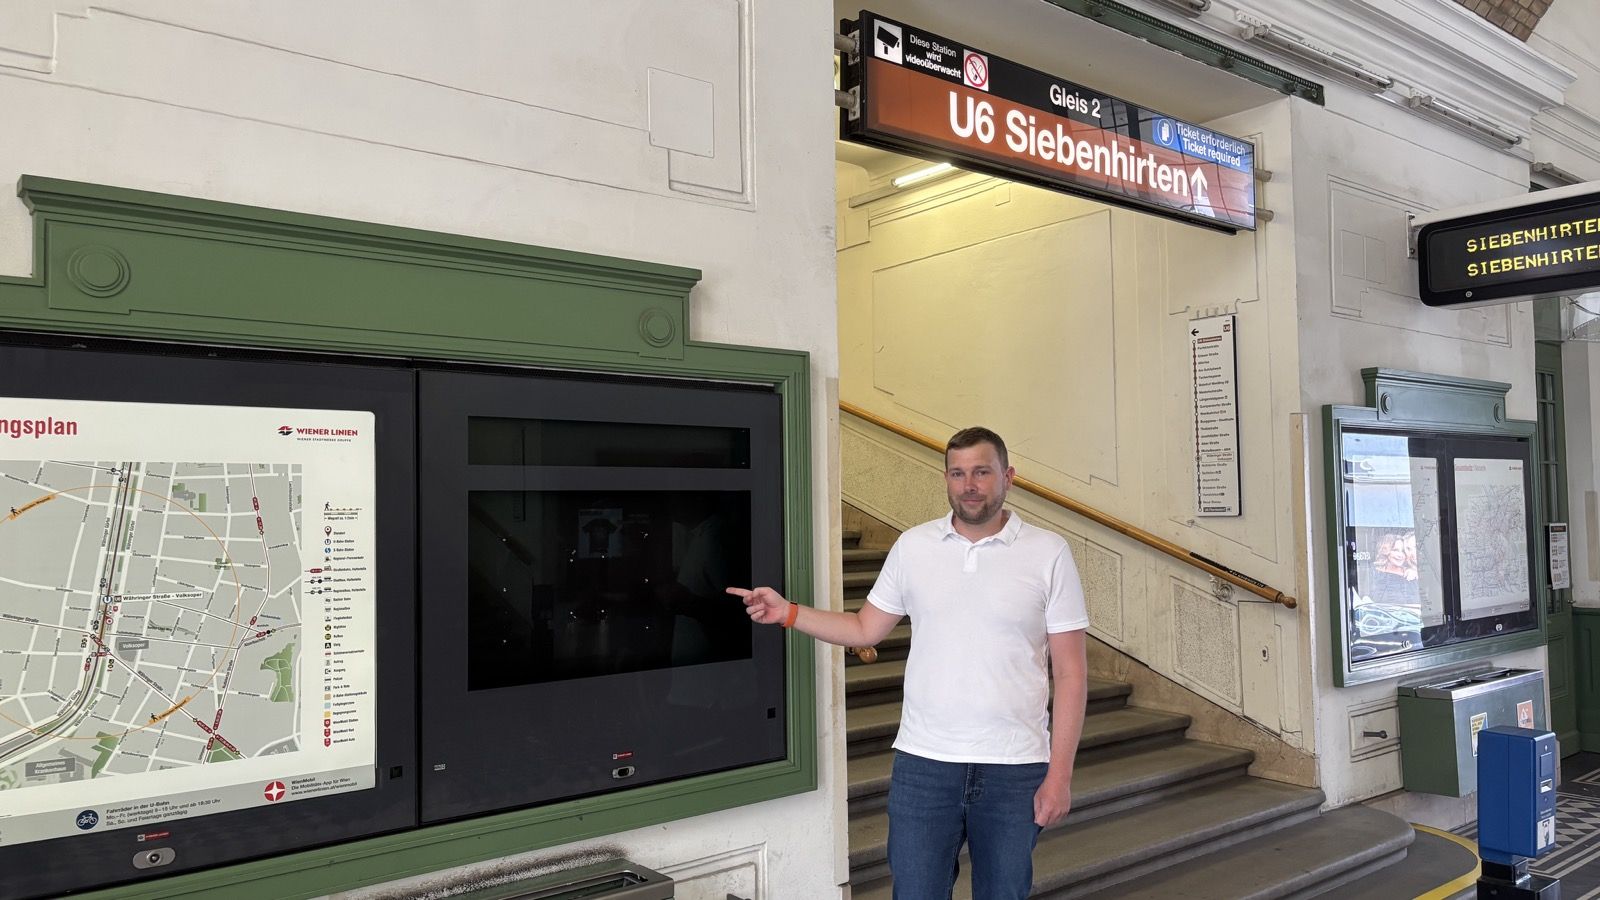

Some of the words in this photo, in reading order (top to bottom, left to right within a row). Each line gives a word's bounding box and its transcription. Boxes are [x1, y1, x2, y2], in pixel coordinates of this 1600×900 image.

[909, 34, 930, 49] Diese
[931, 41, 957, 58] Station
[926, 51, 942, 62] wird
[905, 53, 962, 79] videoüberwacht
[1049, 84, 1088, 114] Gleis
[1091, 98, 1101, 119] 2
[949, 91, 995, 144] U6
[1005, 109, 1188, 197] Siebenhirten
[1176, 122, 1200, 141] Ticket
[1201, 134, 1246, 156] erforderlich
[1182, 138, 1207, 156] Ticket
[1207, 147, 1241, 167] required
[1466, 218, 1600, 253] SIEBENHIRTE
[1467, 244, 1600, 277] SIEBENHIRTE
[296, 428, 330, 436] WIENER
[106, 806, 133, 814] Fahrräder
